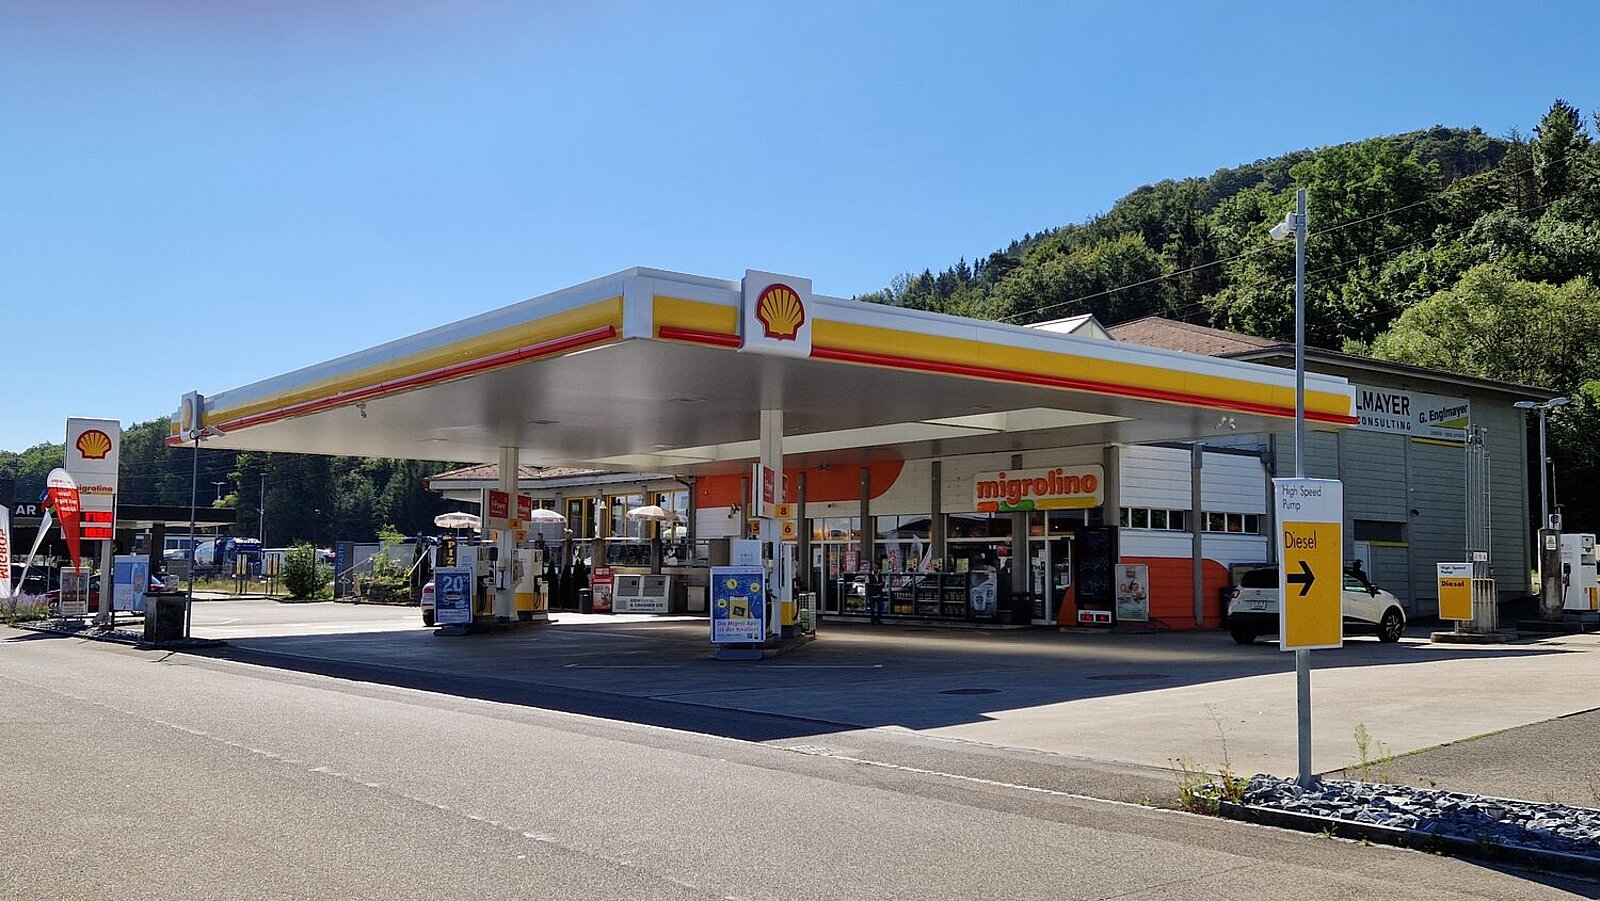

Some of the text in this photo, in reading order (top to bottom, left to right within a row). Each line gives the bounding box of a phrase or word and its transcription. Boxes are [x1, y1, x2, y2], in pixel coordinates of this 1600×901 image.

[1419, 404, 1468, 424] G. Englmayer
[77, 484, 113, 493] igrolino
[976, 468, 1098, 505] migrolino
[1282, 484, 1322, 498] High Speed
[780, 506, 788, 516] 8
[1282, 499, 1301, 511] Pump
[752, 522, 760, 532] 5
[784, 524, 792, 534] 6
[517, 532, 524, 540] 2
[1284, 529, 1318, 549] Diesel
[446, 541, 456, 567] PIZ
